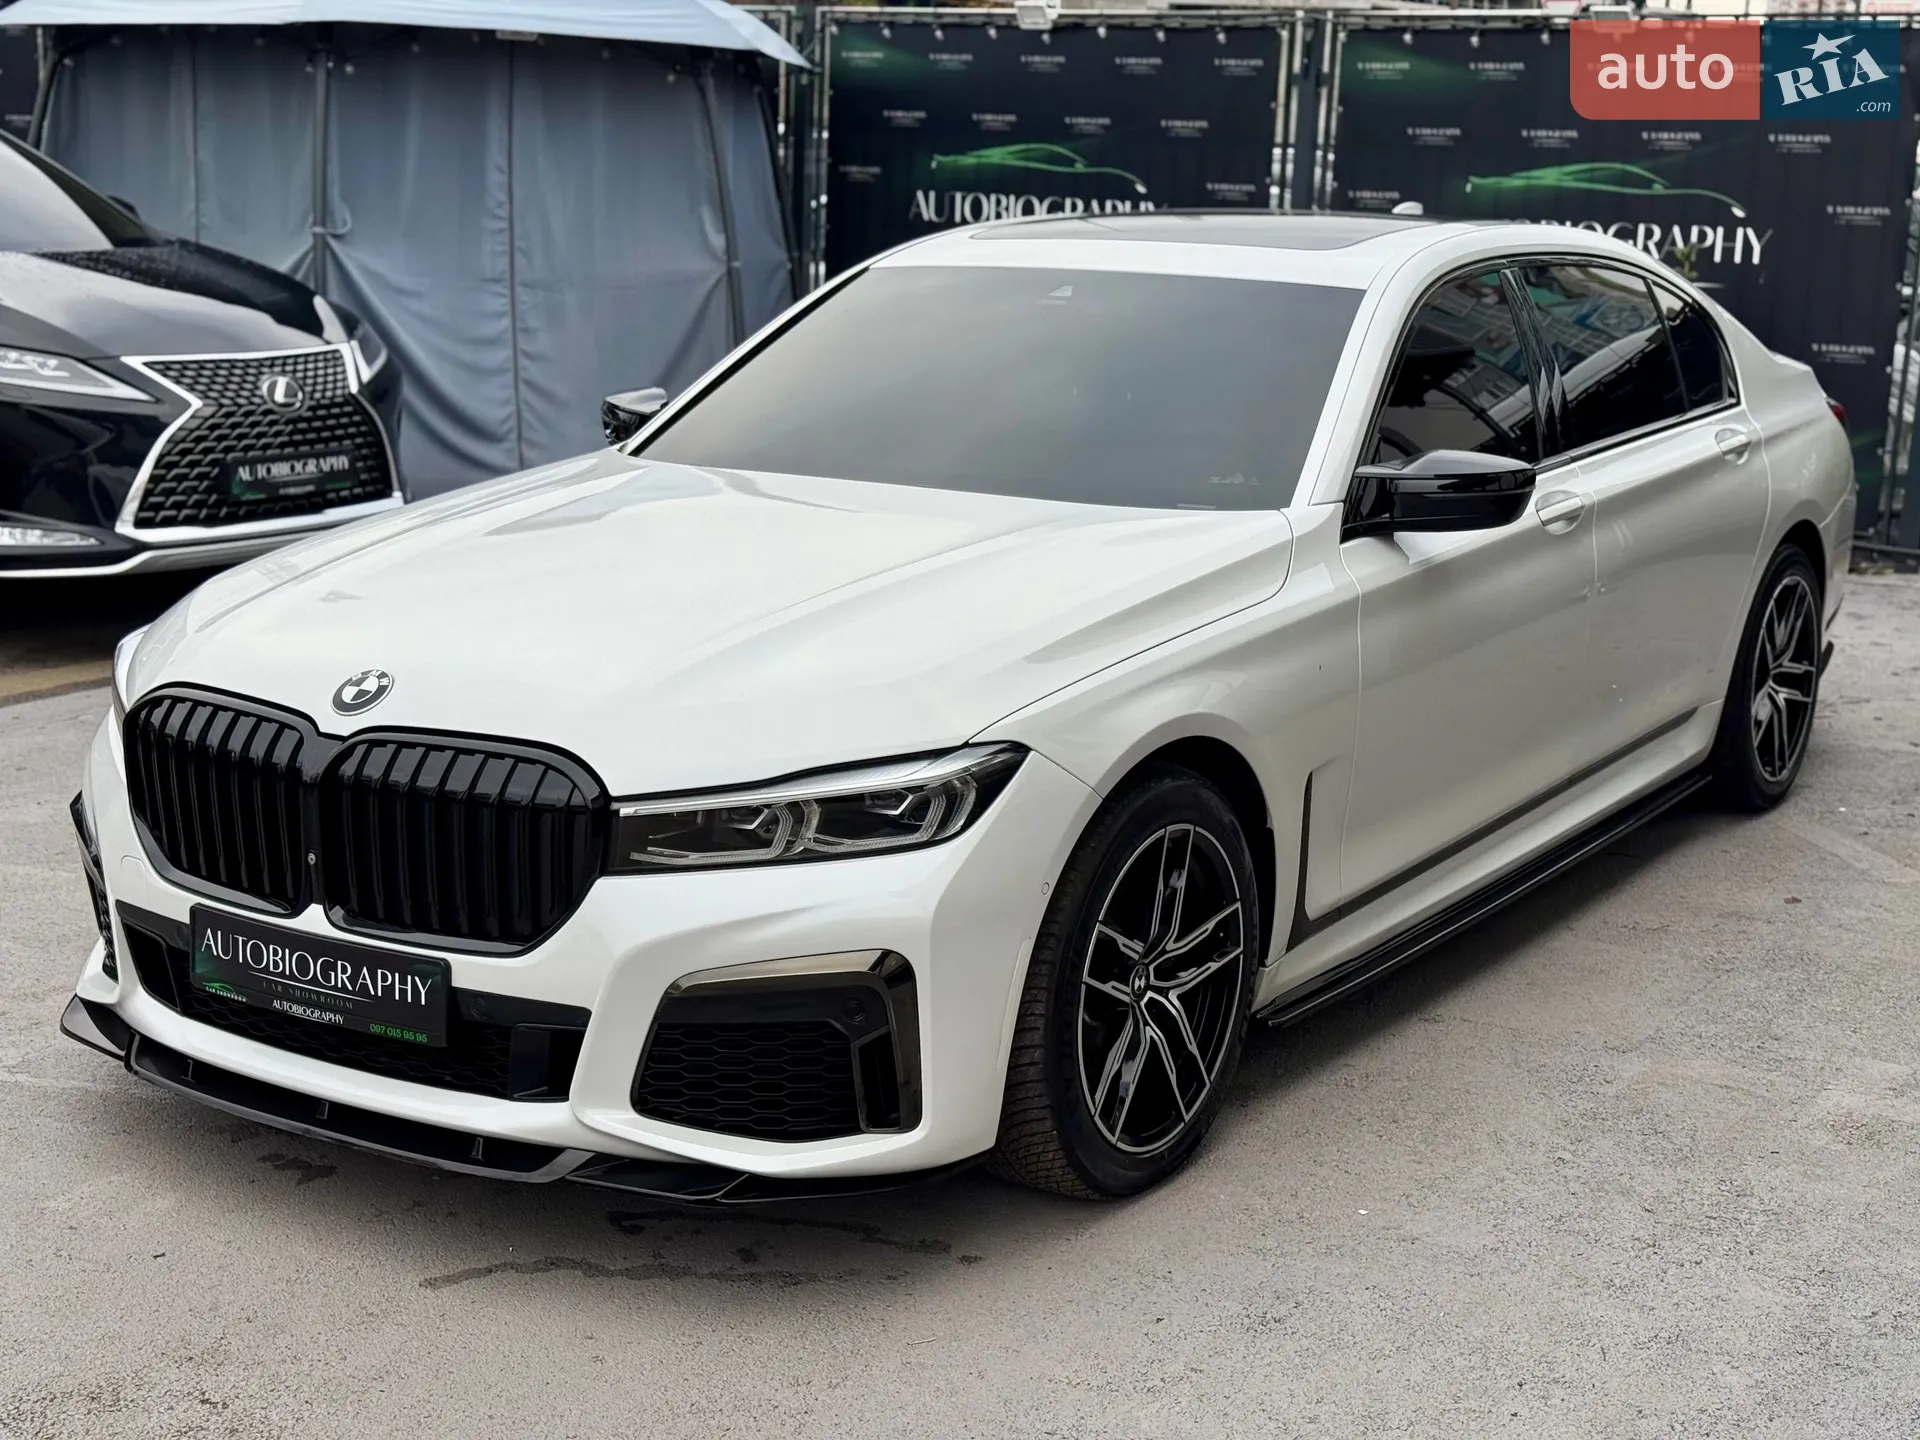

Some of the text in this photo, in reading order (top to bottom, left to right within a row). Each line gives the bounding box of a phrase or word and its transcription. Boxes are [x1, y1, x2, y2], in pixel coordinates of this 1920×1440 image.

[201, 927, 432, 1006] AUTOBIOGRAPHY
[271, 998, 345, 1025] AUTOBIOGRAPHY
[369, 1023, 386, 1034] 097
[386, 1027, 402, 1038] 015
